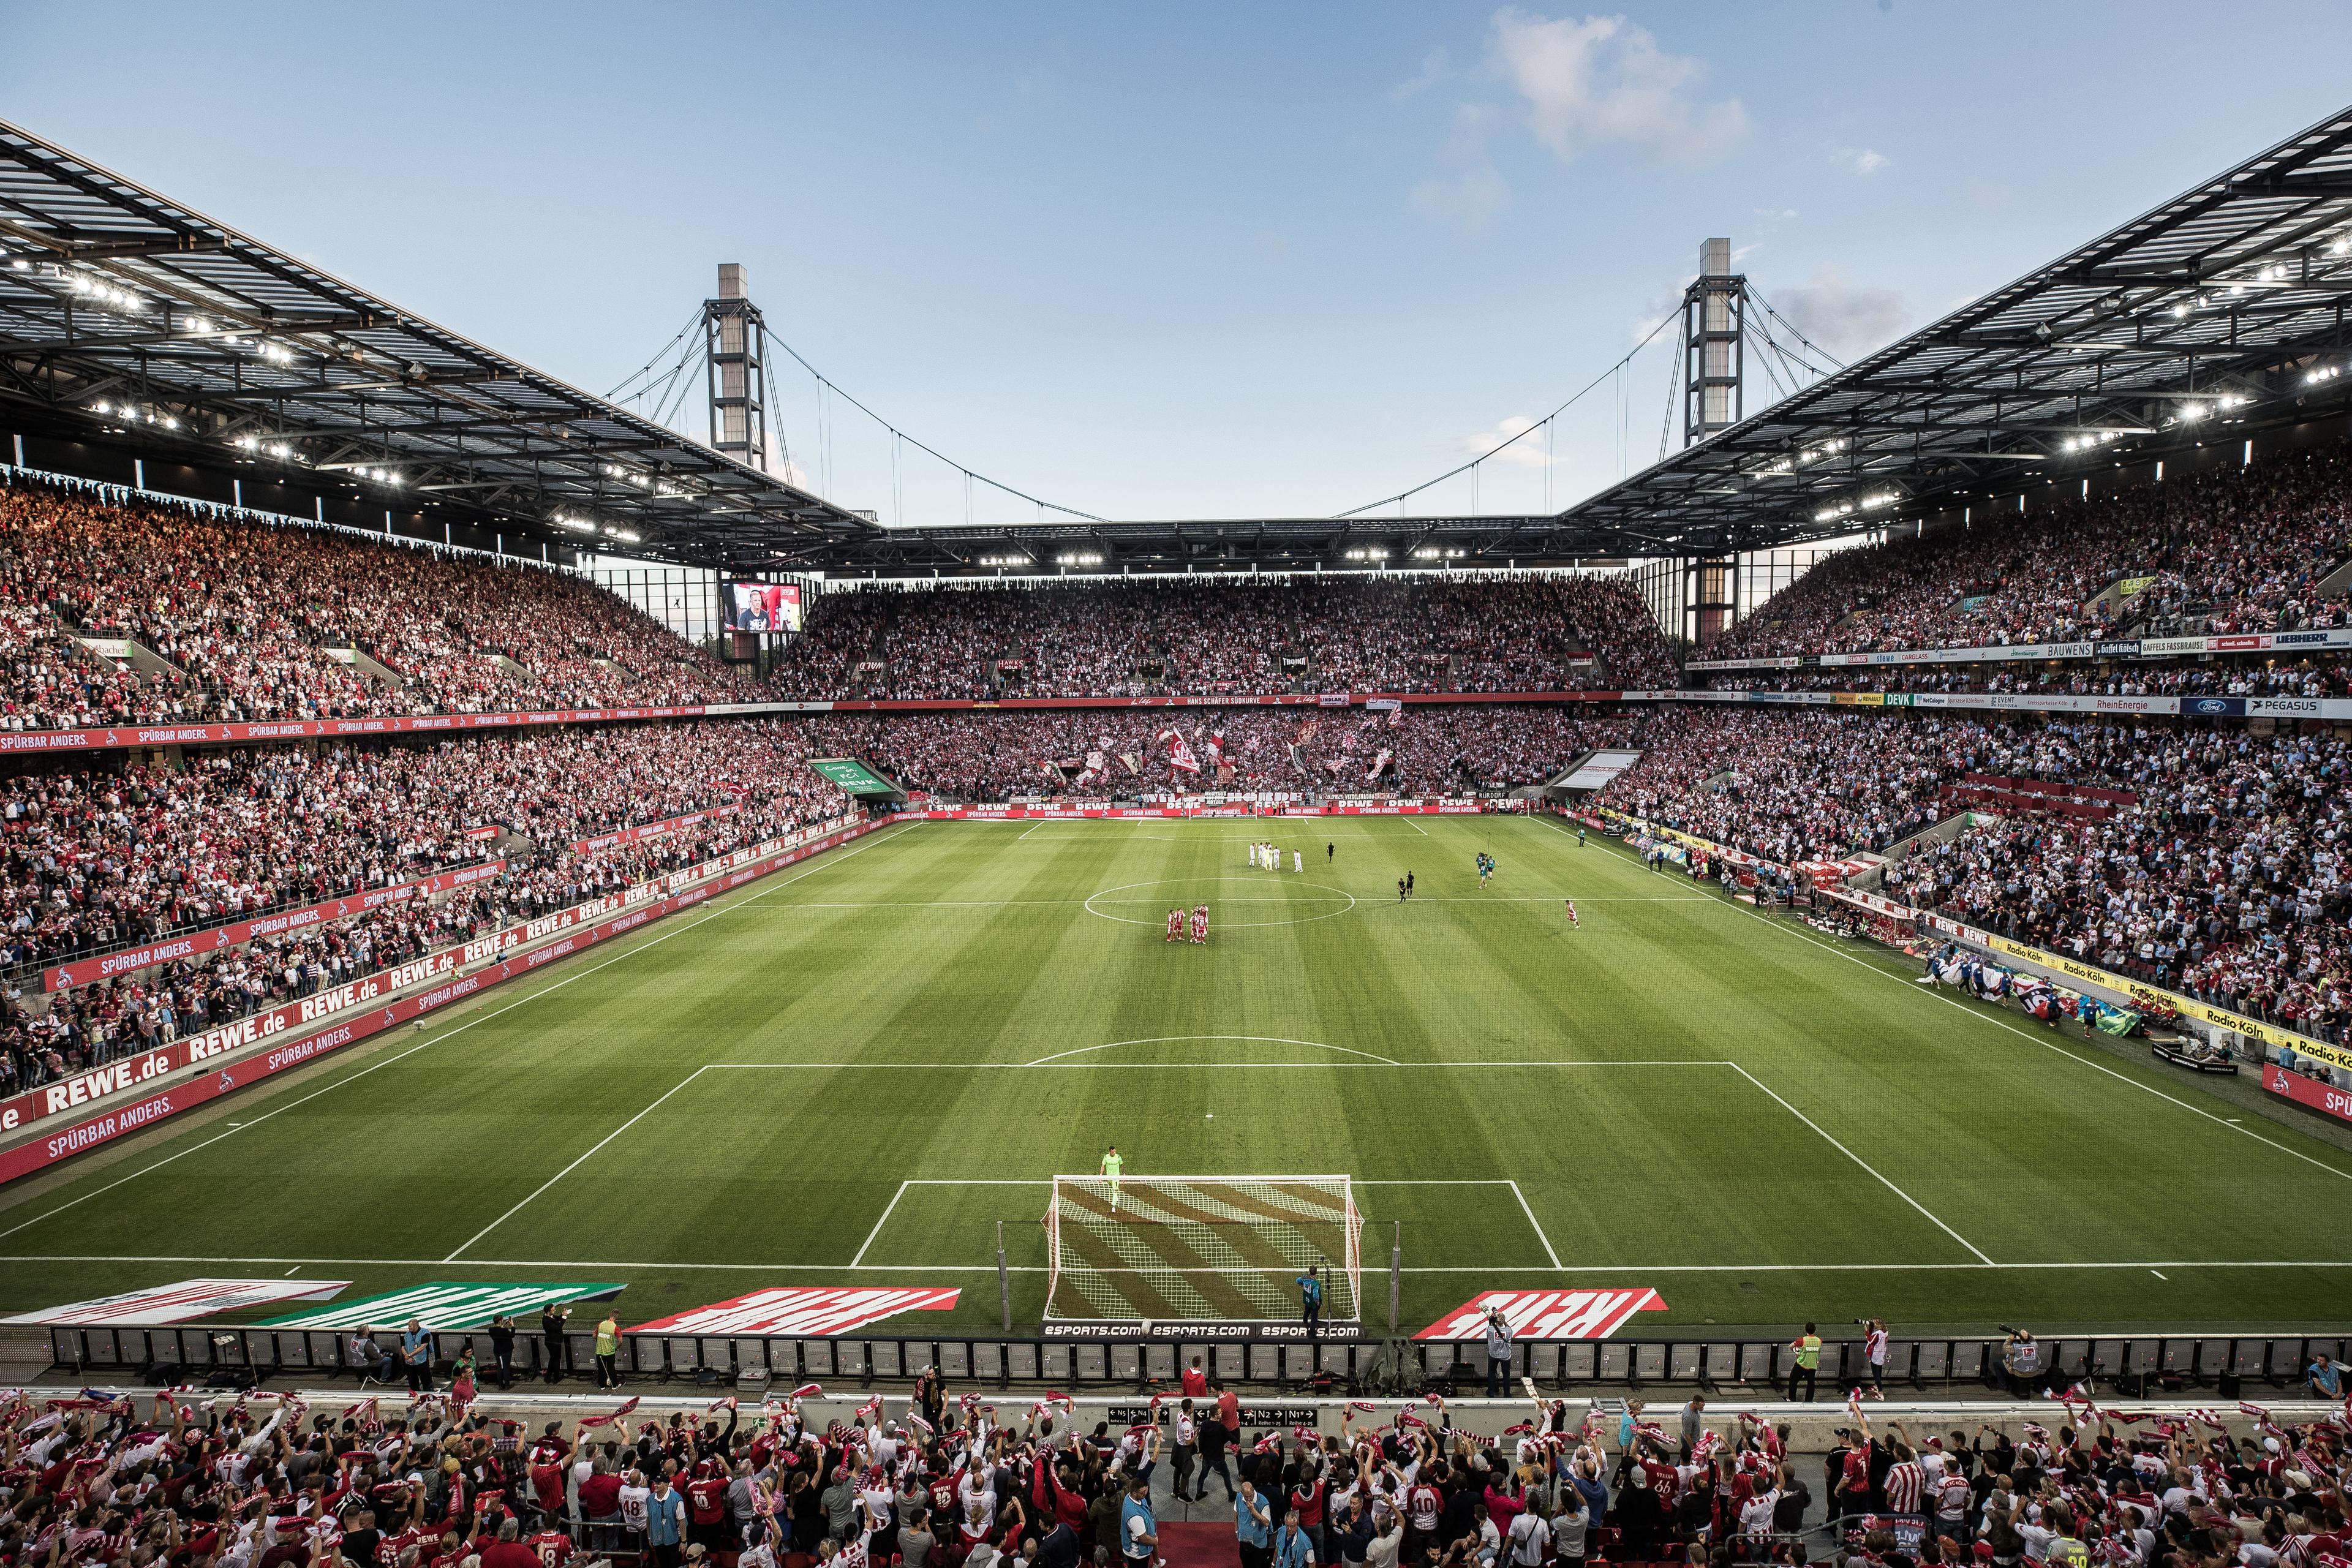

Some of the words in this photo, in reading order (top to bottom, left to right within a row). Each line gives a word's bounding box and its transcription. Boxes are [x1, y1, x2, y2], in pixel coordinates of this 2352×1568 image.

[2143, 643, 2165, 651] GAFFELS
[2166, 641, 2203, 650] FASSBRAUSE
[2275, 633, 2328, 643] LIEBHERR
[2048, 644, 2090, 657] BAUWENS
[2101, 644, 2118, 654] Gaffel
[1283, 657, 1306, 666] TROIKA
[1887, 694, 1910, 705] DEVK
[2097, 699, 2148, 711] RheinEnergie
[2203, 701, 2220, 710] Ford
[2265, 701, 2317, 711] PEGASUS
[412, 717, 433, 728] SPÜRBAR
[434, 716, 452, 727] ANDERS.
[475, 714, 493, 725] SPÜRBAR
[494, 714, 510, 724] ANDERS.
[529, 712, 545, 722] SPÜRBAR
[545, 712, 559, 721] ANDERS.
[575, 710, 589, 719] SPÜRBAR
[590, 709, 602, 718] ANDERS.
[249, 725, 279, 736] SPÜRBAR
[279, 724, 305, 734] ANDERS.
[337, 721, 363, 732] SPÜRBAR
[364, 720, 385, 731] ANDERS.
[1, 736, 48, 749] SPÜRBAR
[50, 734, 89, 747] ANDERS.
[139, 731, 176, 742] SPÜRBAR
[177, 729, 209, 740] ANDERS.
[760, 840, 782, 856] REWE.de
[733, 849, 757, 865] REWE.de
[453, 871, 478, 884] SPÜRBAR
[478, 865, 499, 878] ANDERS.
[703, 858, 729, 877] REWE.de
[669, 868, 699, 889] REWE.de
[624, 882, 659, 905] REWE.de
[677, 894, 693, 907] SPÜRBAR
[694, 888, 707, 900] ANDERS.
[579, 896, 619, 922] REWE.de
[1868, 896, 1886, 910] REWE
[1894, 905, 1908, 918] REWE
[250, 916, 288, 937] SPÜRBAR
[289, 909, 320, 927] ANDERS.
[527, 912, 571, 941] REWE.de
[612, 918, 631, 933] SPÜRBAR
[631, 911, 648, 925] ANDERS.
[1936, 918, 1958, 936] REWE
[1964, 929, 1988, 946] REWE
[464, 931, 518, 964] REWE.de
[528, 949, 552, 967] SPÜRBAR
[554, 940, 575, 957] ANDERS.
[2007, 943, 2026, 957] Radio
[2027, 949, 2043, 963] Köln
[100, 951, 151, 975] SPÜRBAR
[153, 940, 195, 961] ANDERS.
[390, 953, 454, 990] REWE.de
[2064, 962, 2086, 978] Radio
[2087, 970, 2105, 985] Köln
[301, 980, 379, 1023] REWE.de
[418, 988, 451, 1011] SPÜRBAR
[453, 976, 480, 997] ANDERS.
[2207, 1010, 2237, 1029] Radio
[2239, 1020, 2263, 1039] Köln
[188, 1012, 285, 1063] REWE.de
[269, 1042, 314, 1069] SPÜRBAR
[315, 1027, 353, 1054] ANDERS.
[2299, 1041, 2335, 1062] Radio
[2175, 1058, 2198, 1068] BUNDESLIGA
[46, 1054, 169, 1114] REWE.de
[48, 1116, 116, 1158] SPÜRBAR
[120, 1096, 174, 1130] ANDERS.
[1258, 1410, 1271, 1419] N2
[222, 1466, 233, 1483] 7
[1654, 1481, 1670, 1494] 66
[694, 1494, 710, 1510] 10
[935, 1492, 951, 1508] 10
[1416, 1496, 1434, 1509] 10
[417, 1533, 439, 1545] REWE
[545, 1549, 556, 1568] 8
